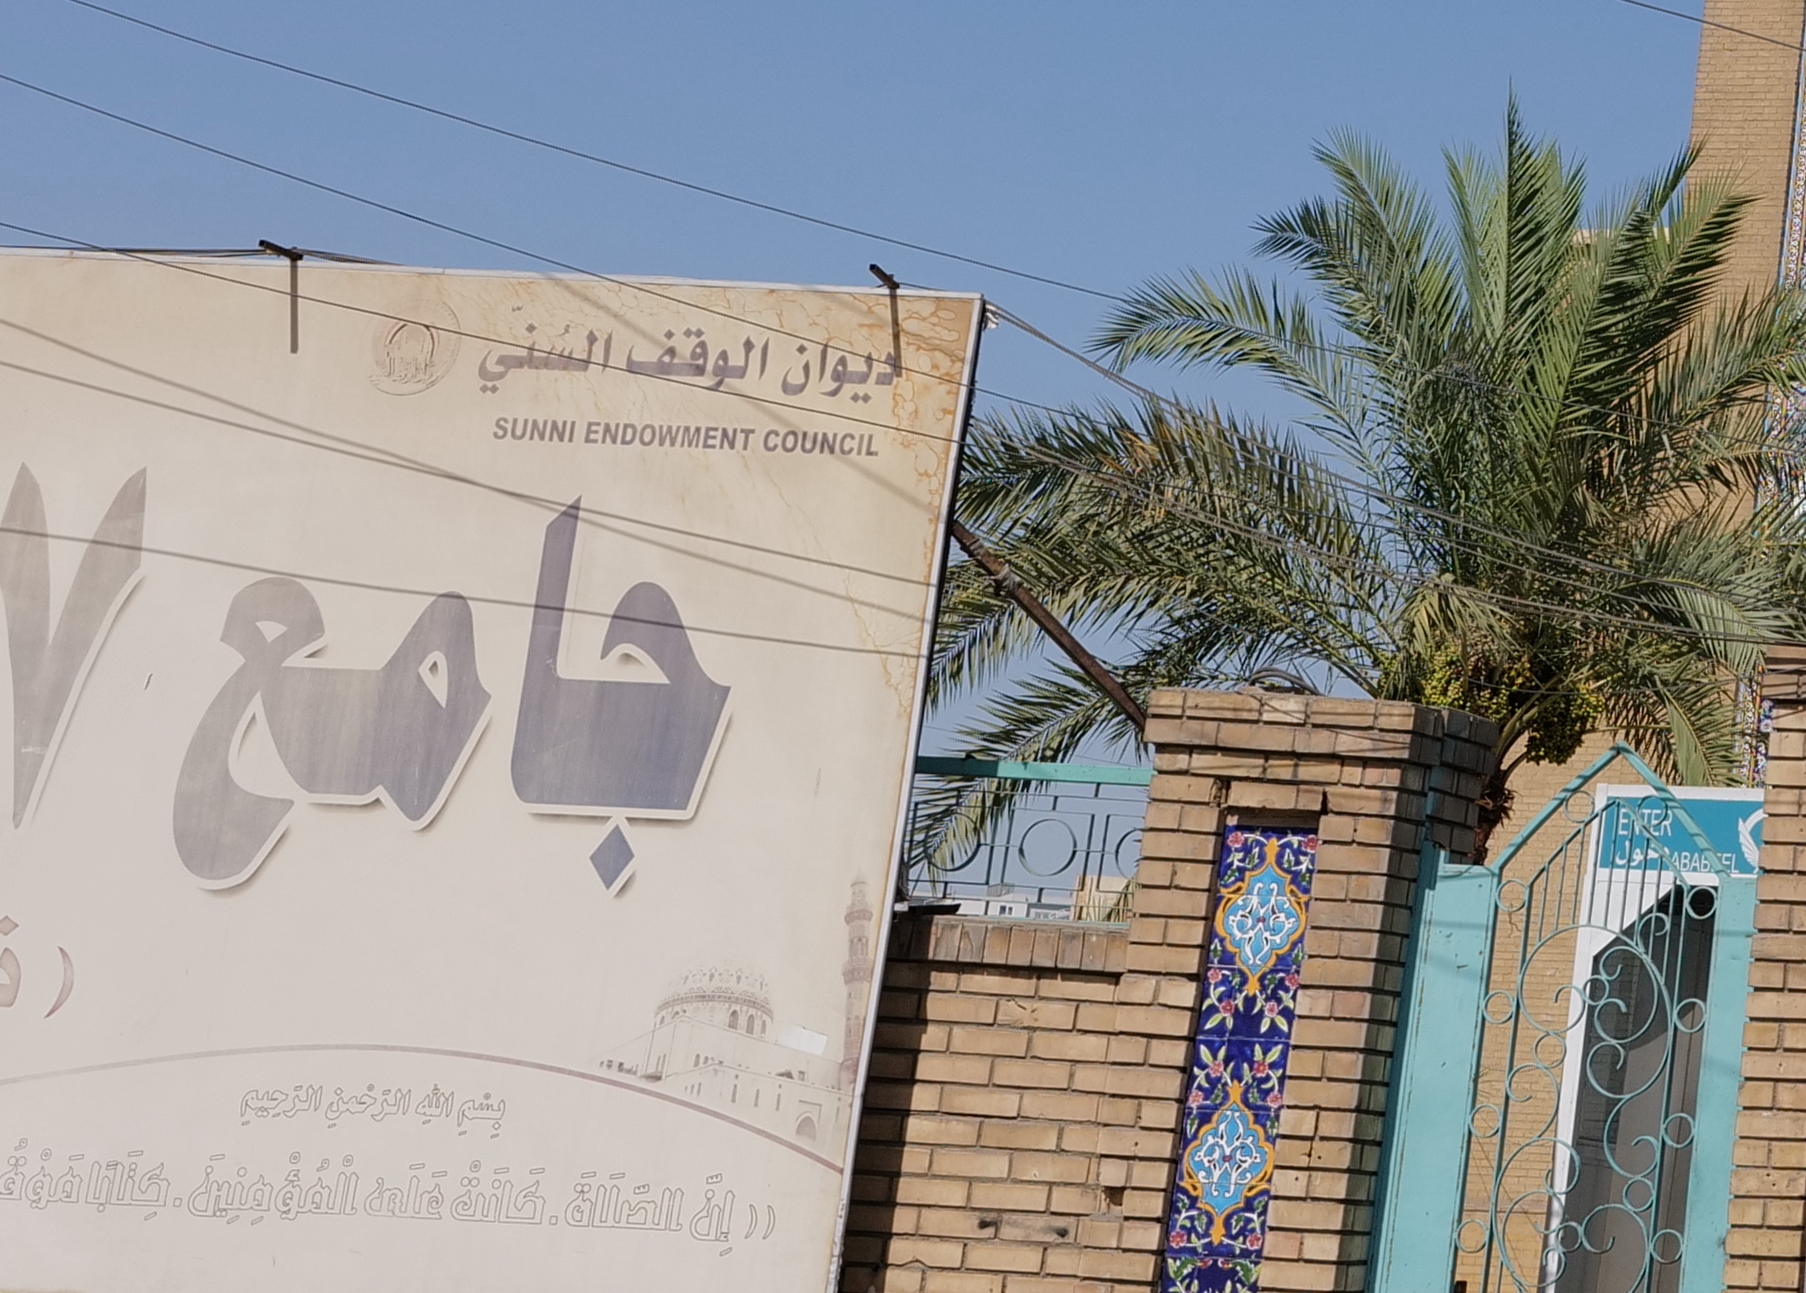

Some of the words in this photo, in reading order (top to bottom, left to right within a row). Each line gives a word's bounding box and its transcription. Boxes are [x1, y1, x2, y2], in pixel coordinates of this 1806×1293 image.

[625, 327, 770, 391] الوقف
[781, 343, 898, 404] ديوان
[491, 416, 577, 443] SUNNI
[583, 421, 757, 452] ENDOWMENT
[762, 428, 881, 458] COUNCIL
[171, 494, 734, 892] جامع
[1669, 851, 1740, 873] ABABEL
